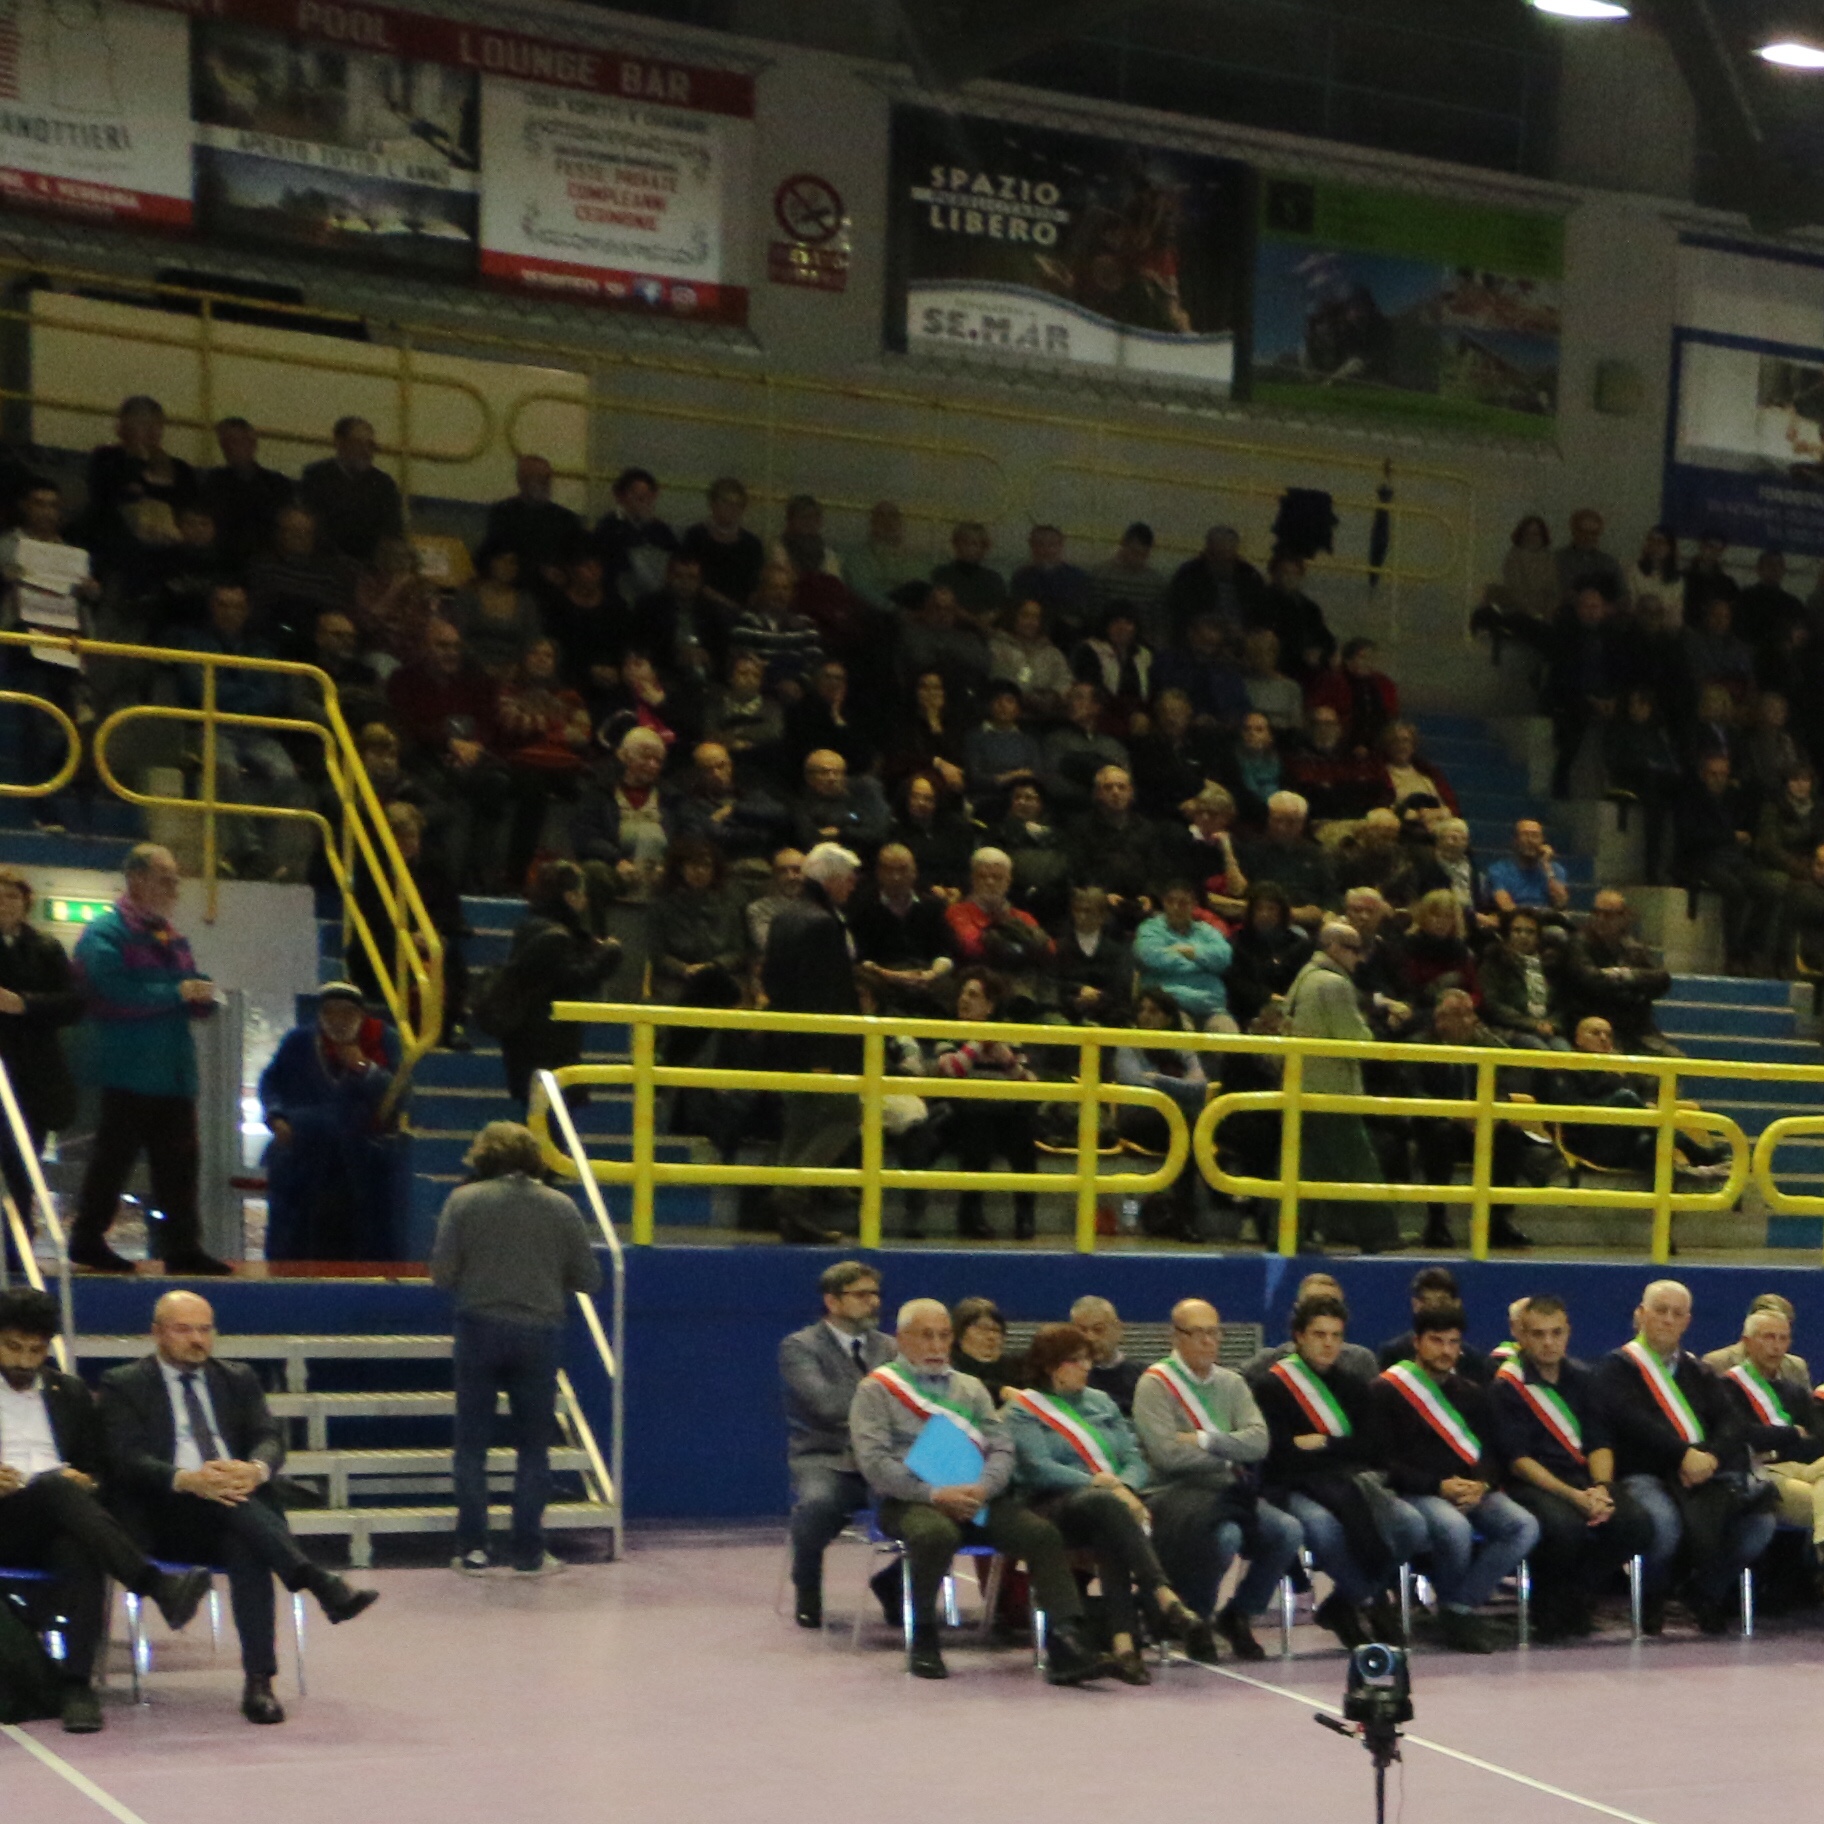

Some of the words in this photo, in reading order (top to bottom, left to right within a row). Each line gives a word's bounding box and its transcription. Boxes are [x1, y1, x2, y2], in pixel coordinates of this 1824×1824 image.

[296, 2, 397, 50] POOL
[458, 30, 601, 87] LOUNGE
[619, 60, 691, 101] BAR
[930, 166, 1061, 205] SPAZIO
[930, 206, 1059, 247] LIBERO
